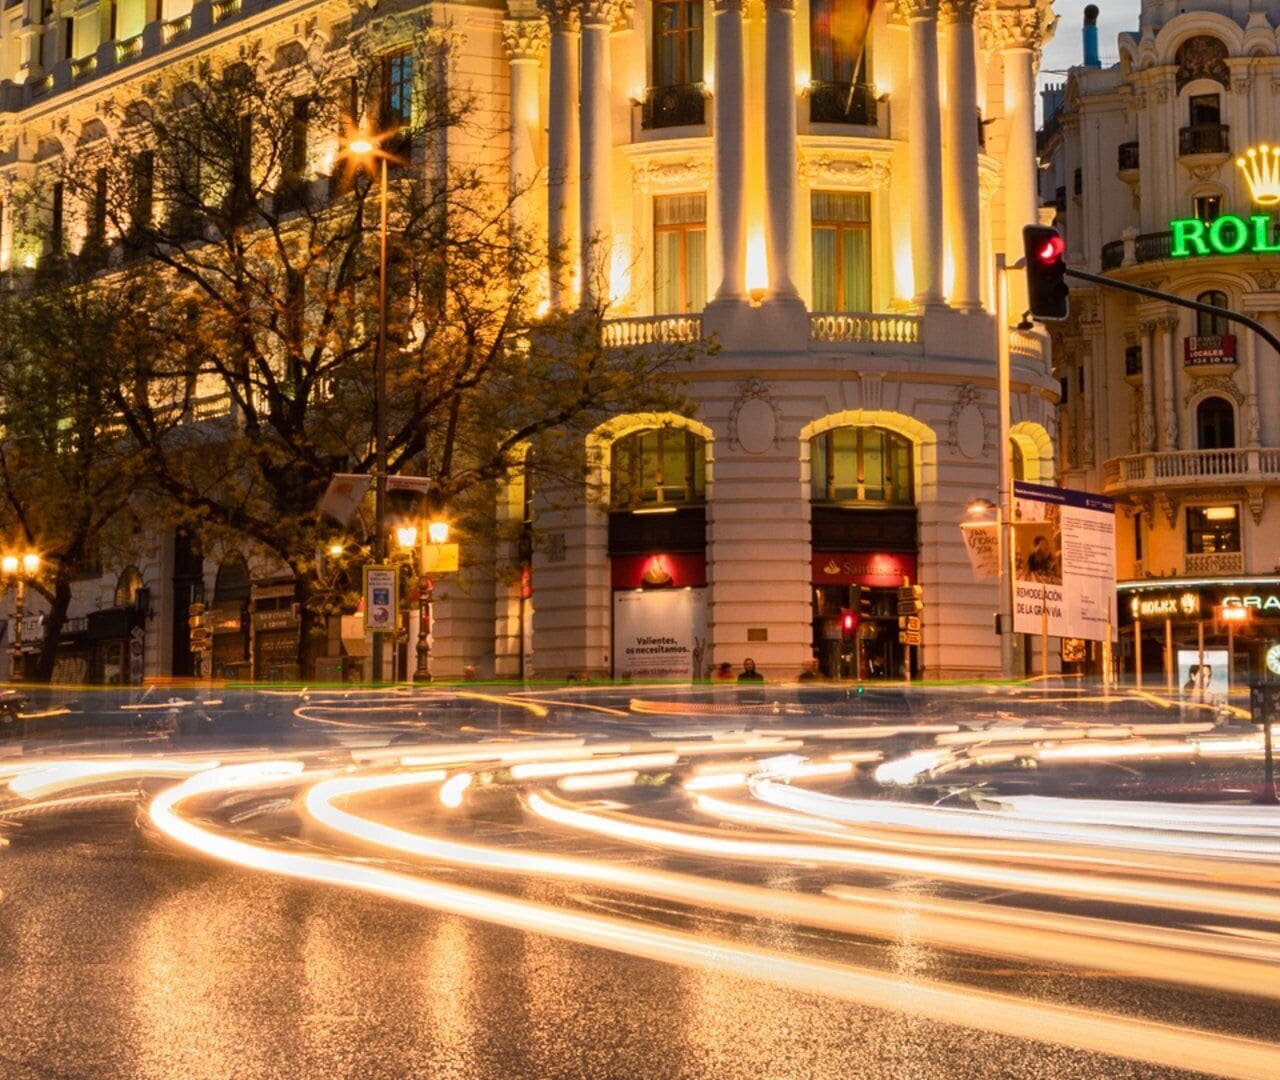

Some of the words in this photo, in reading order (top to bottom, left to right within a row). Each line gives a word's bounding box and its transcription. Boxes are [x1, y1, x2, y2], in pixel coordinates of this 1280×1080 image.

[1190, 350, 1224, 358] LOCALES
[1017, 603, 1024, 614] DE
[1026, 605, 1033, 615] LA
[636, 636, 678, 646] Valientes,
